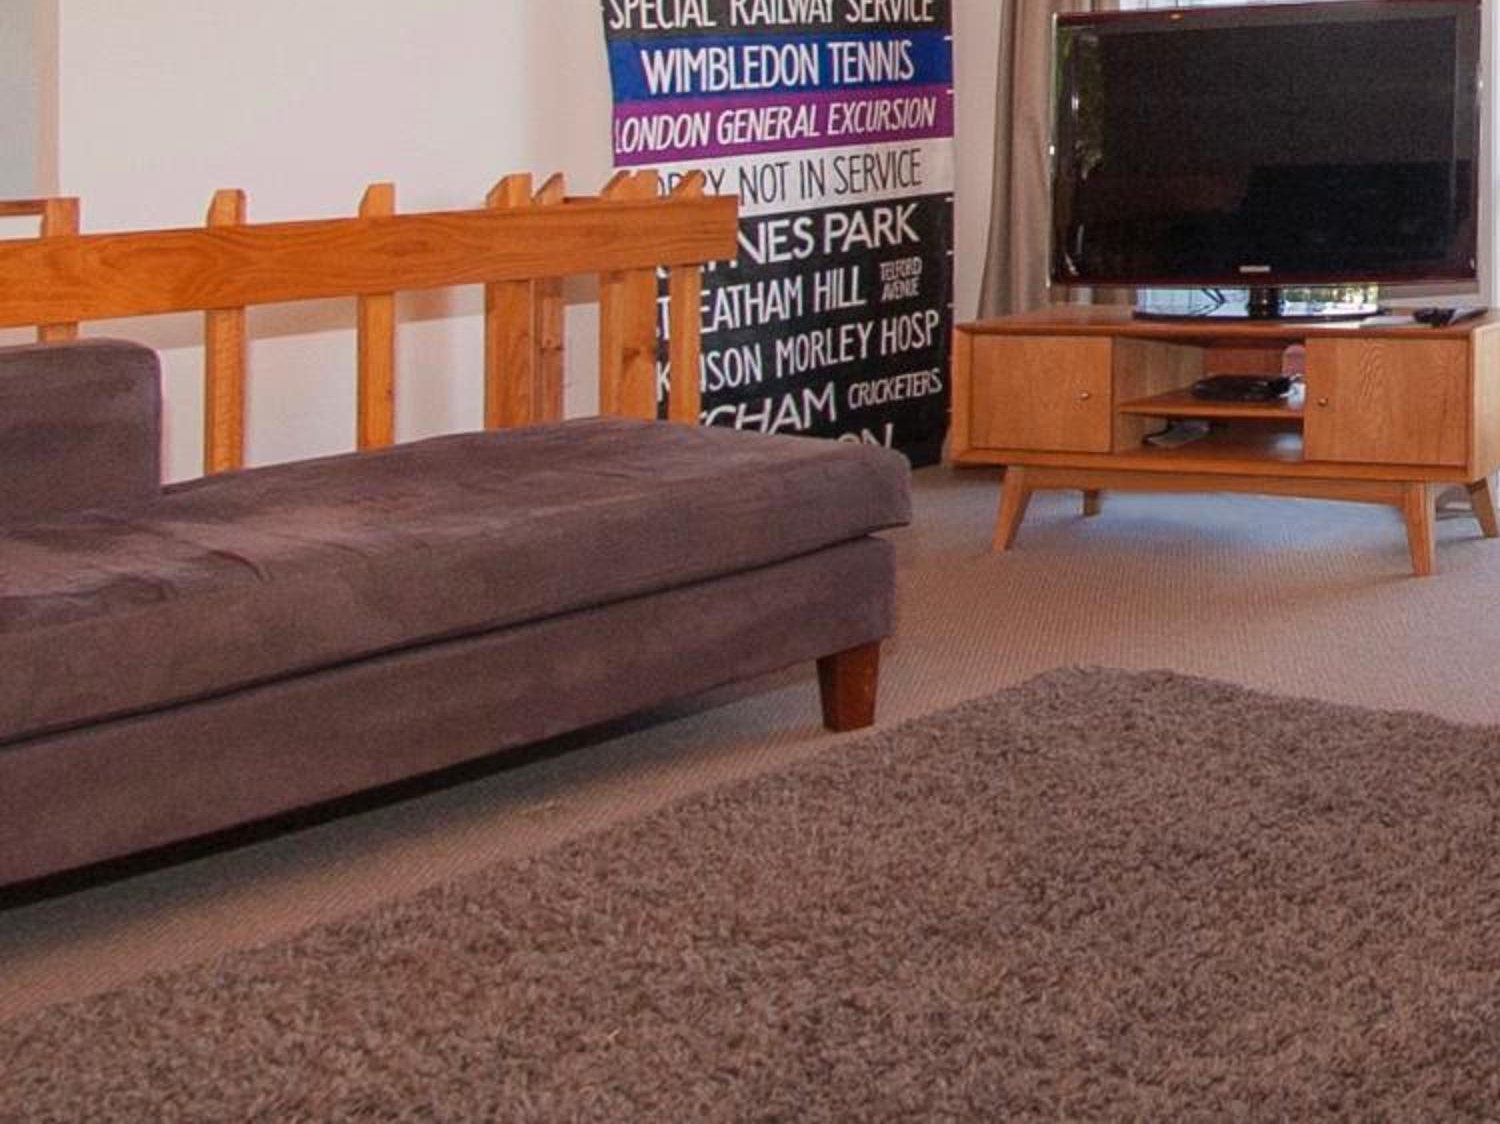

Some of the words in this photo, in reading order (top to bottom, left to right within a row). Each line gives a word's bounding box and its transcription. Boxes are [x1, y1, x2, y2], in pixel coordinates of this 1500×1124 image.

[640, 43, 820, 95] WIMBLEDON
[827, 39, 915, 85] TENNIS
[614, 112, 711, 154] LONDON
[717, 105, 821, 144] GENERAL
[827, 97, 937, 136] EXCURSION
[740, 161, 790, 206] NOT
[799, 159, 826, 200] IN
[833, 148, 923, 195] SERVICE
[823, 203, 921, 256] PARK
[814, 266, 867, 313] HILL
[775, 321, 875, 378] MORLEY
[880, 309, 940, 356] HOSP
[848, 368, 944, 410] CRICKETERS
